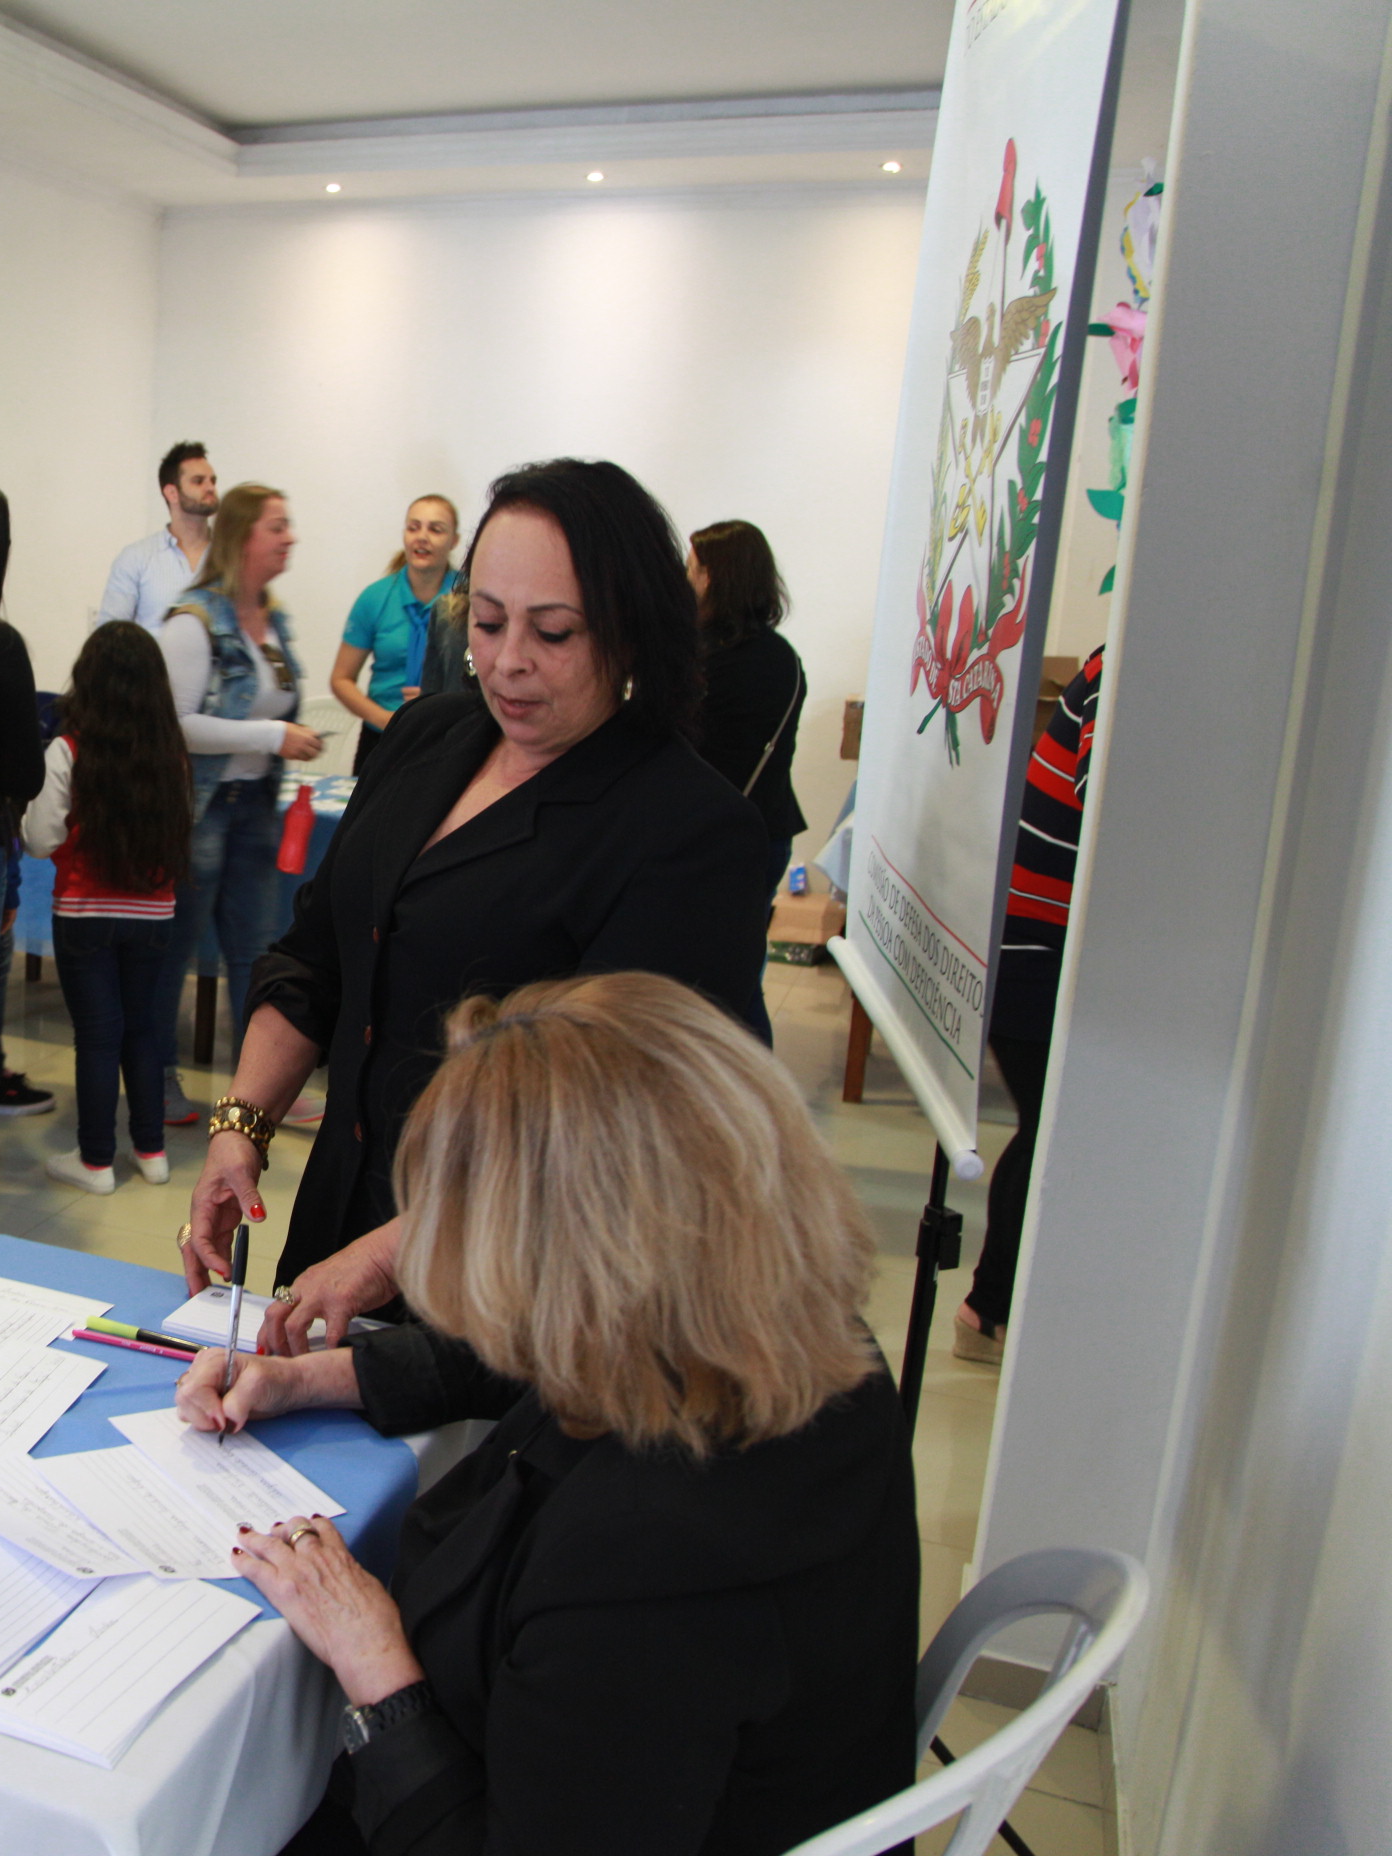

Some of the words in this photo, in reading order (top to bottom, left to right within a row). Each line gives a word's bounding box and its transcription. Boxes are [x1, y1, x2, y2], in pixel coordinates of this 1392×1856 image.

[874, 905, 893, 953] PESSOA
[894, 934, 910, 977] COM
[910, 956, 962, 1045] DEFICIÊNCIA
[889, 884, 900, 915] DE
[899, 895, 922, 947] DEFESA
[923, 925, 940, 967] DOS
